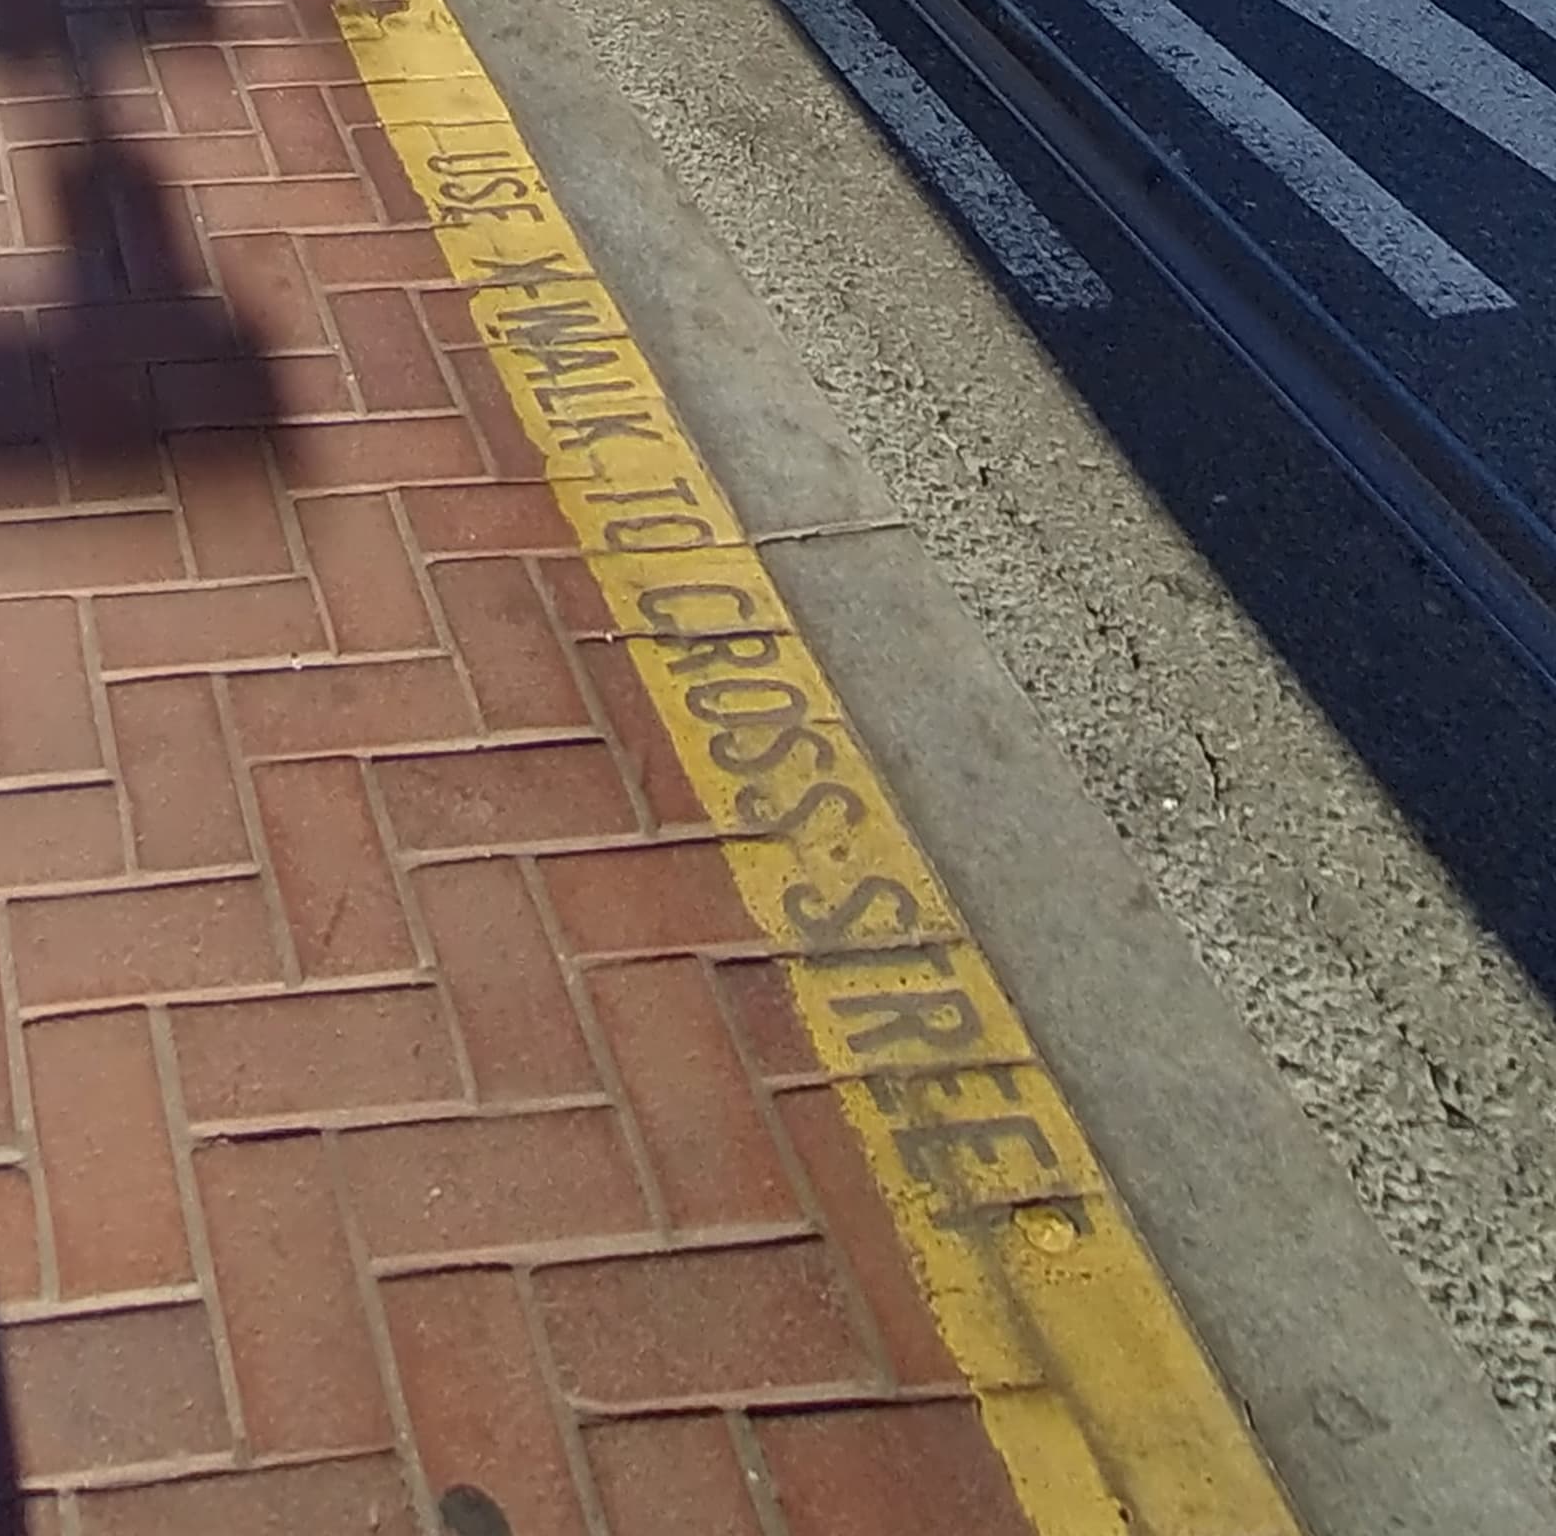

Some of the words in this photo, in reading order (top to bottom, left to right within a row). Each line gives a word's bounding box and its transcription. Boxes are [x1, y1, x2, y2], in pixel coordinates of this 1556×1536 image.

[427, 149, 543, 227] USE
[471, 252, 663, 451] X-WALK
[585, 476, 717, 552] TO
[637, 582, 867, 834] CROSS
[785, 874, 1096, 1240] STREET
